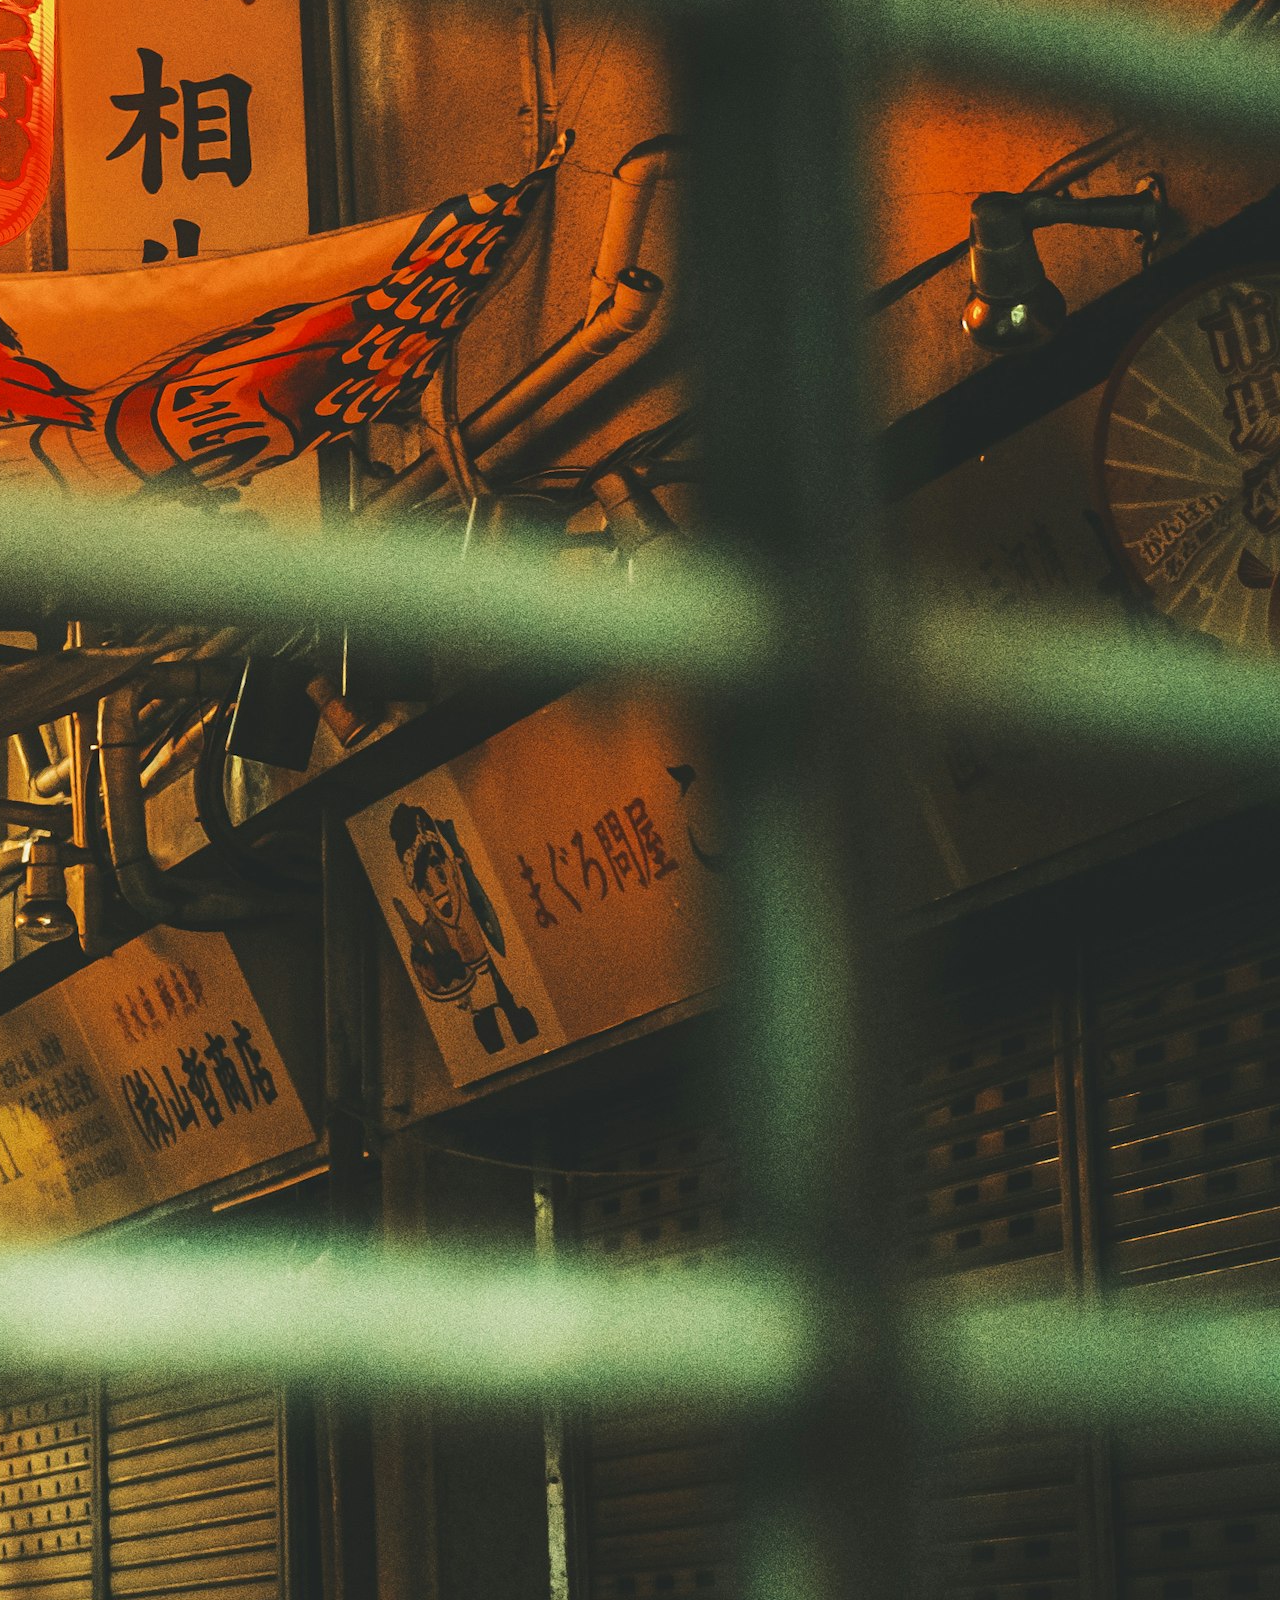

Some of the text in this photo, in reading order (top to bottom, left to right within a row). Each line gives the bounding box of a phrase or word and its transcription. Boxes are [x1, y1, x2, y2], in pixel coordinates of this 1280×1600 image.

[517, 797, 680, 929] まぐろ問屋
[120, 1019, 278, 1153] (株)山哲商店
